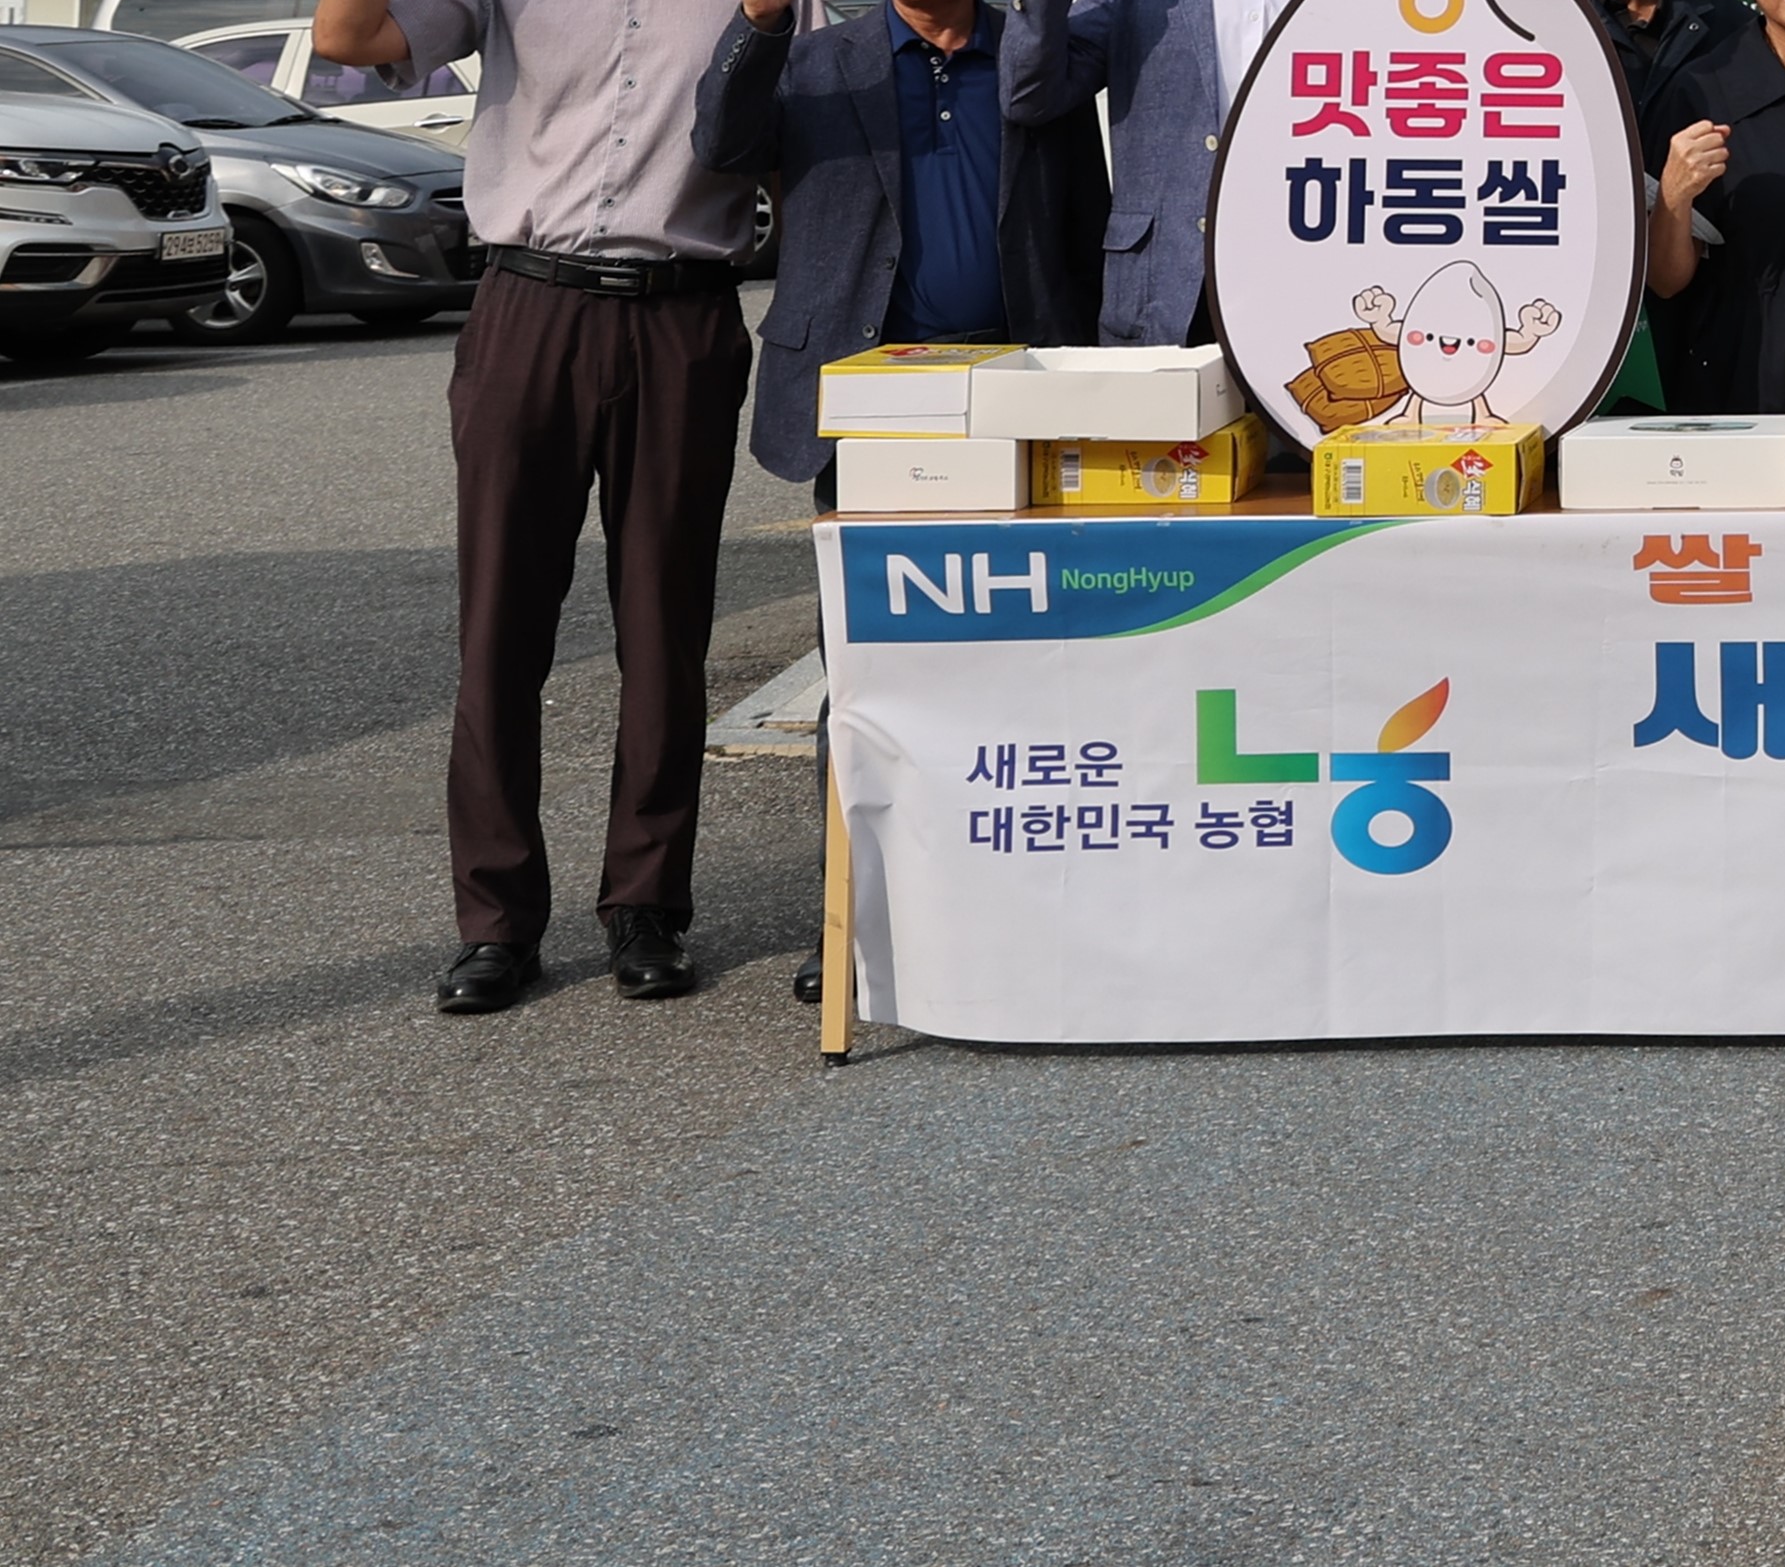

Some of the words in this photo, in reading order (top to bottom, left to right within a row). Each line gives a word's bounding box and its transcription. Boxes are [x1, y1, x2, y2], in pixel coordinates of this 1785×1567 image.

[1290, 49, 1565, 139] 맛좋은
[1285, 157, 1567, 247] 하동쌀
[884, 551, 1049, 616] NH
[1060, 566, 1195, 595] NongHyup
[1632, 530, 1761, 604] 쌀
[966, 739, 1124, 792] 새로운
[967, 800, 1174, 855] 대한민국
[1195, 798, 1295, 851] 농협
